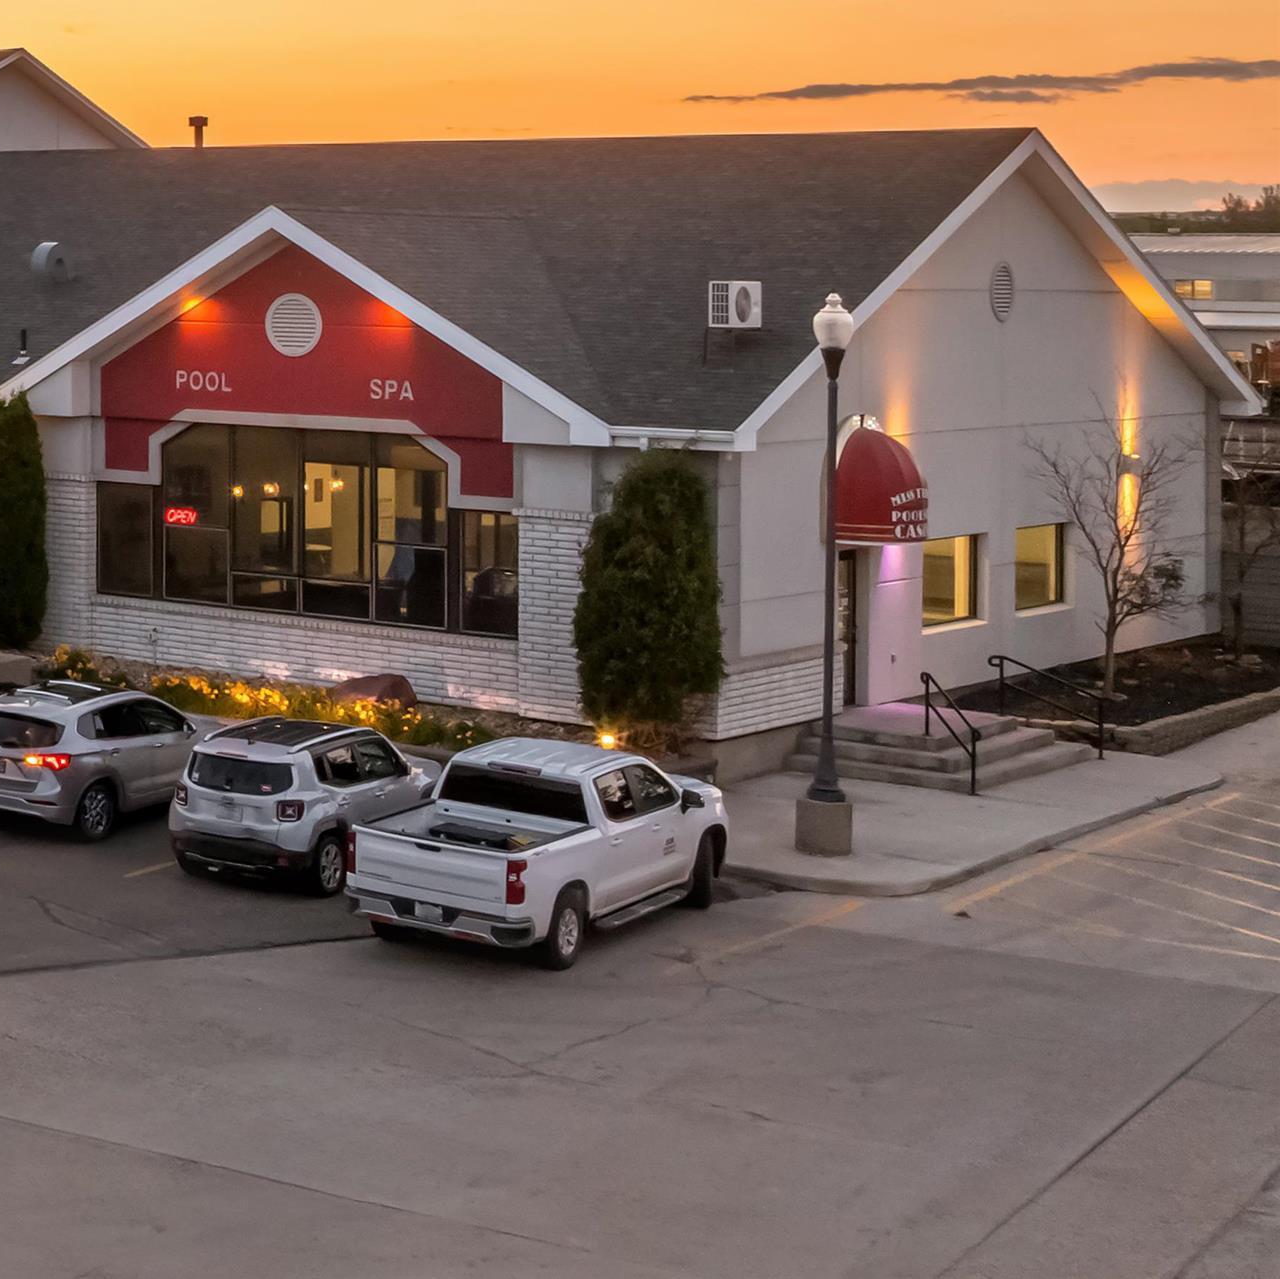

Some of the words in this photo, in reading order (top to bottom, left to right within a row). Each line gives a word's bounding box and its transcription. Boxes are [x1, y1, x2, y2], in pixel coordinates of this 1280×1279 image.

[175, 369, 232, 392] POOL
[369, 378, 414, 401] SPA
[167, 509, 197, 524] OPEN
